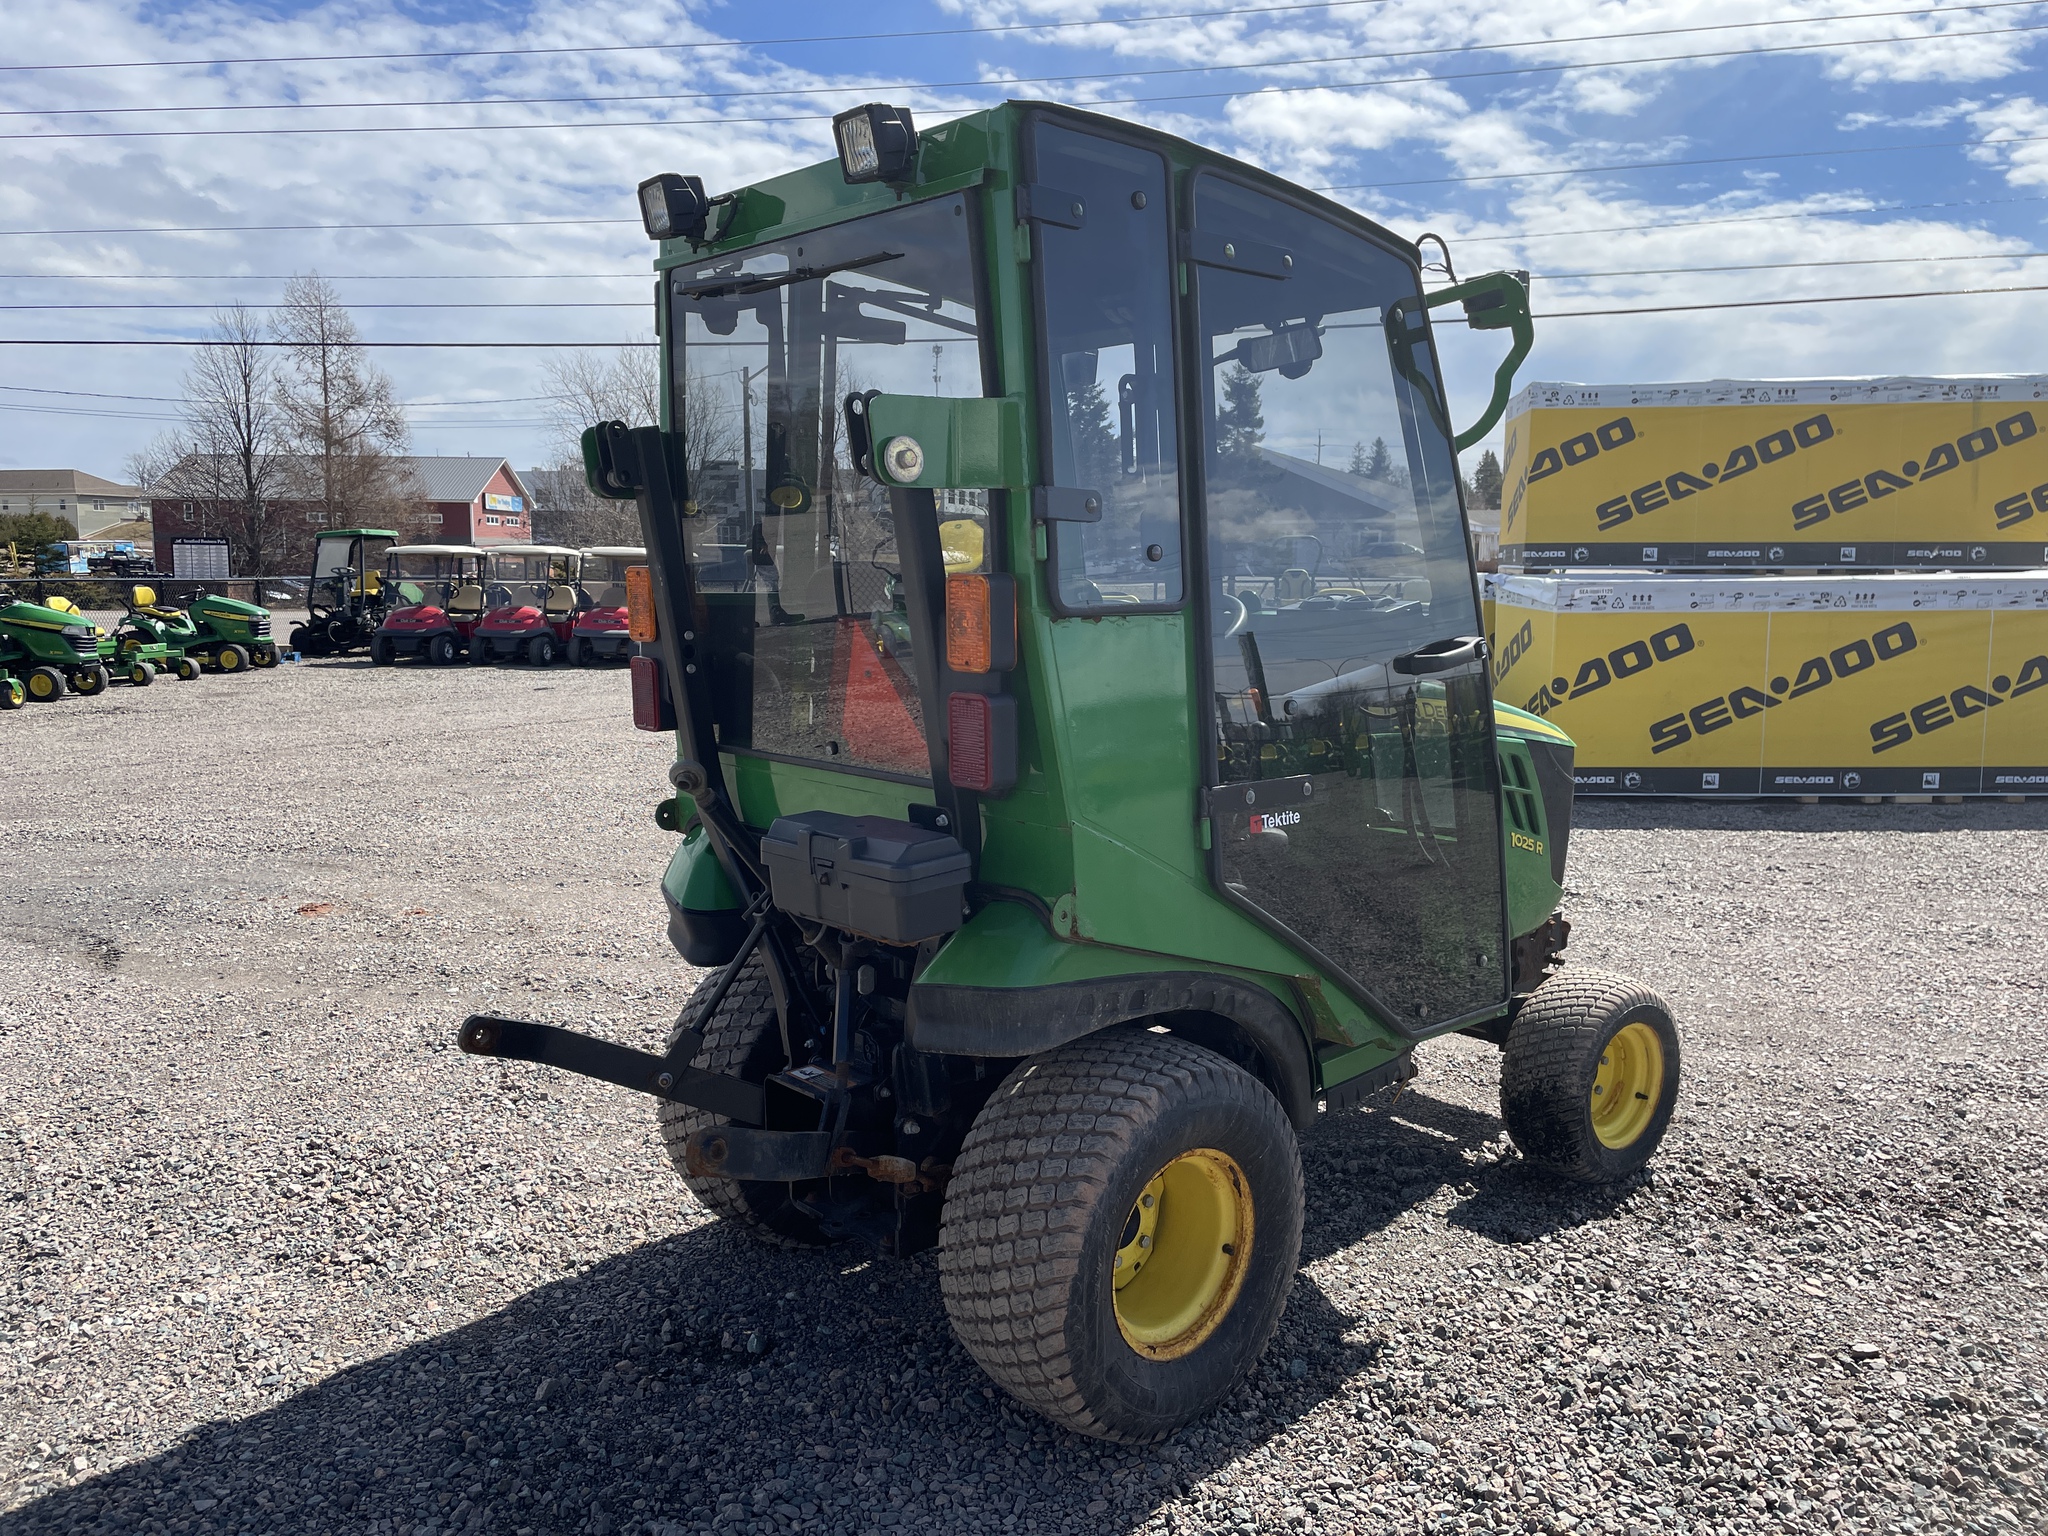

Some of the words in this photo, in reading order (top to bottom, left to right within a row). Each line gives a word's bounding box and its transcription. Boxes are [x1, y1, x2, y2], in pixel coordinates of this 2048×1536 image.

[1261, 811, 1301, 829] Tektite
[1510, 832, 1535, 852] 1025
[1536, 841, 1544, 856] R
